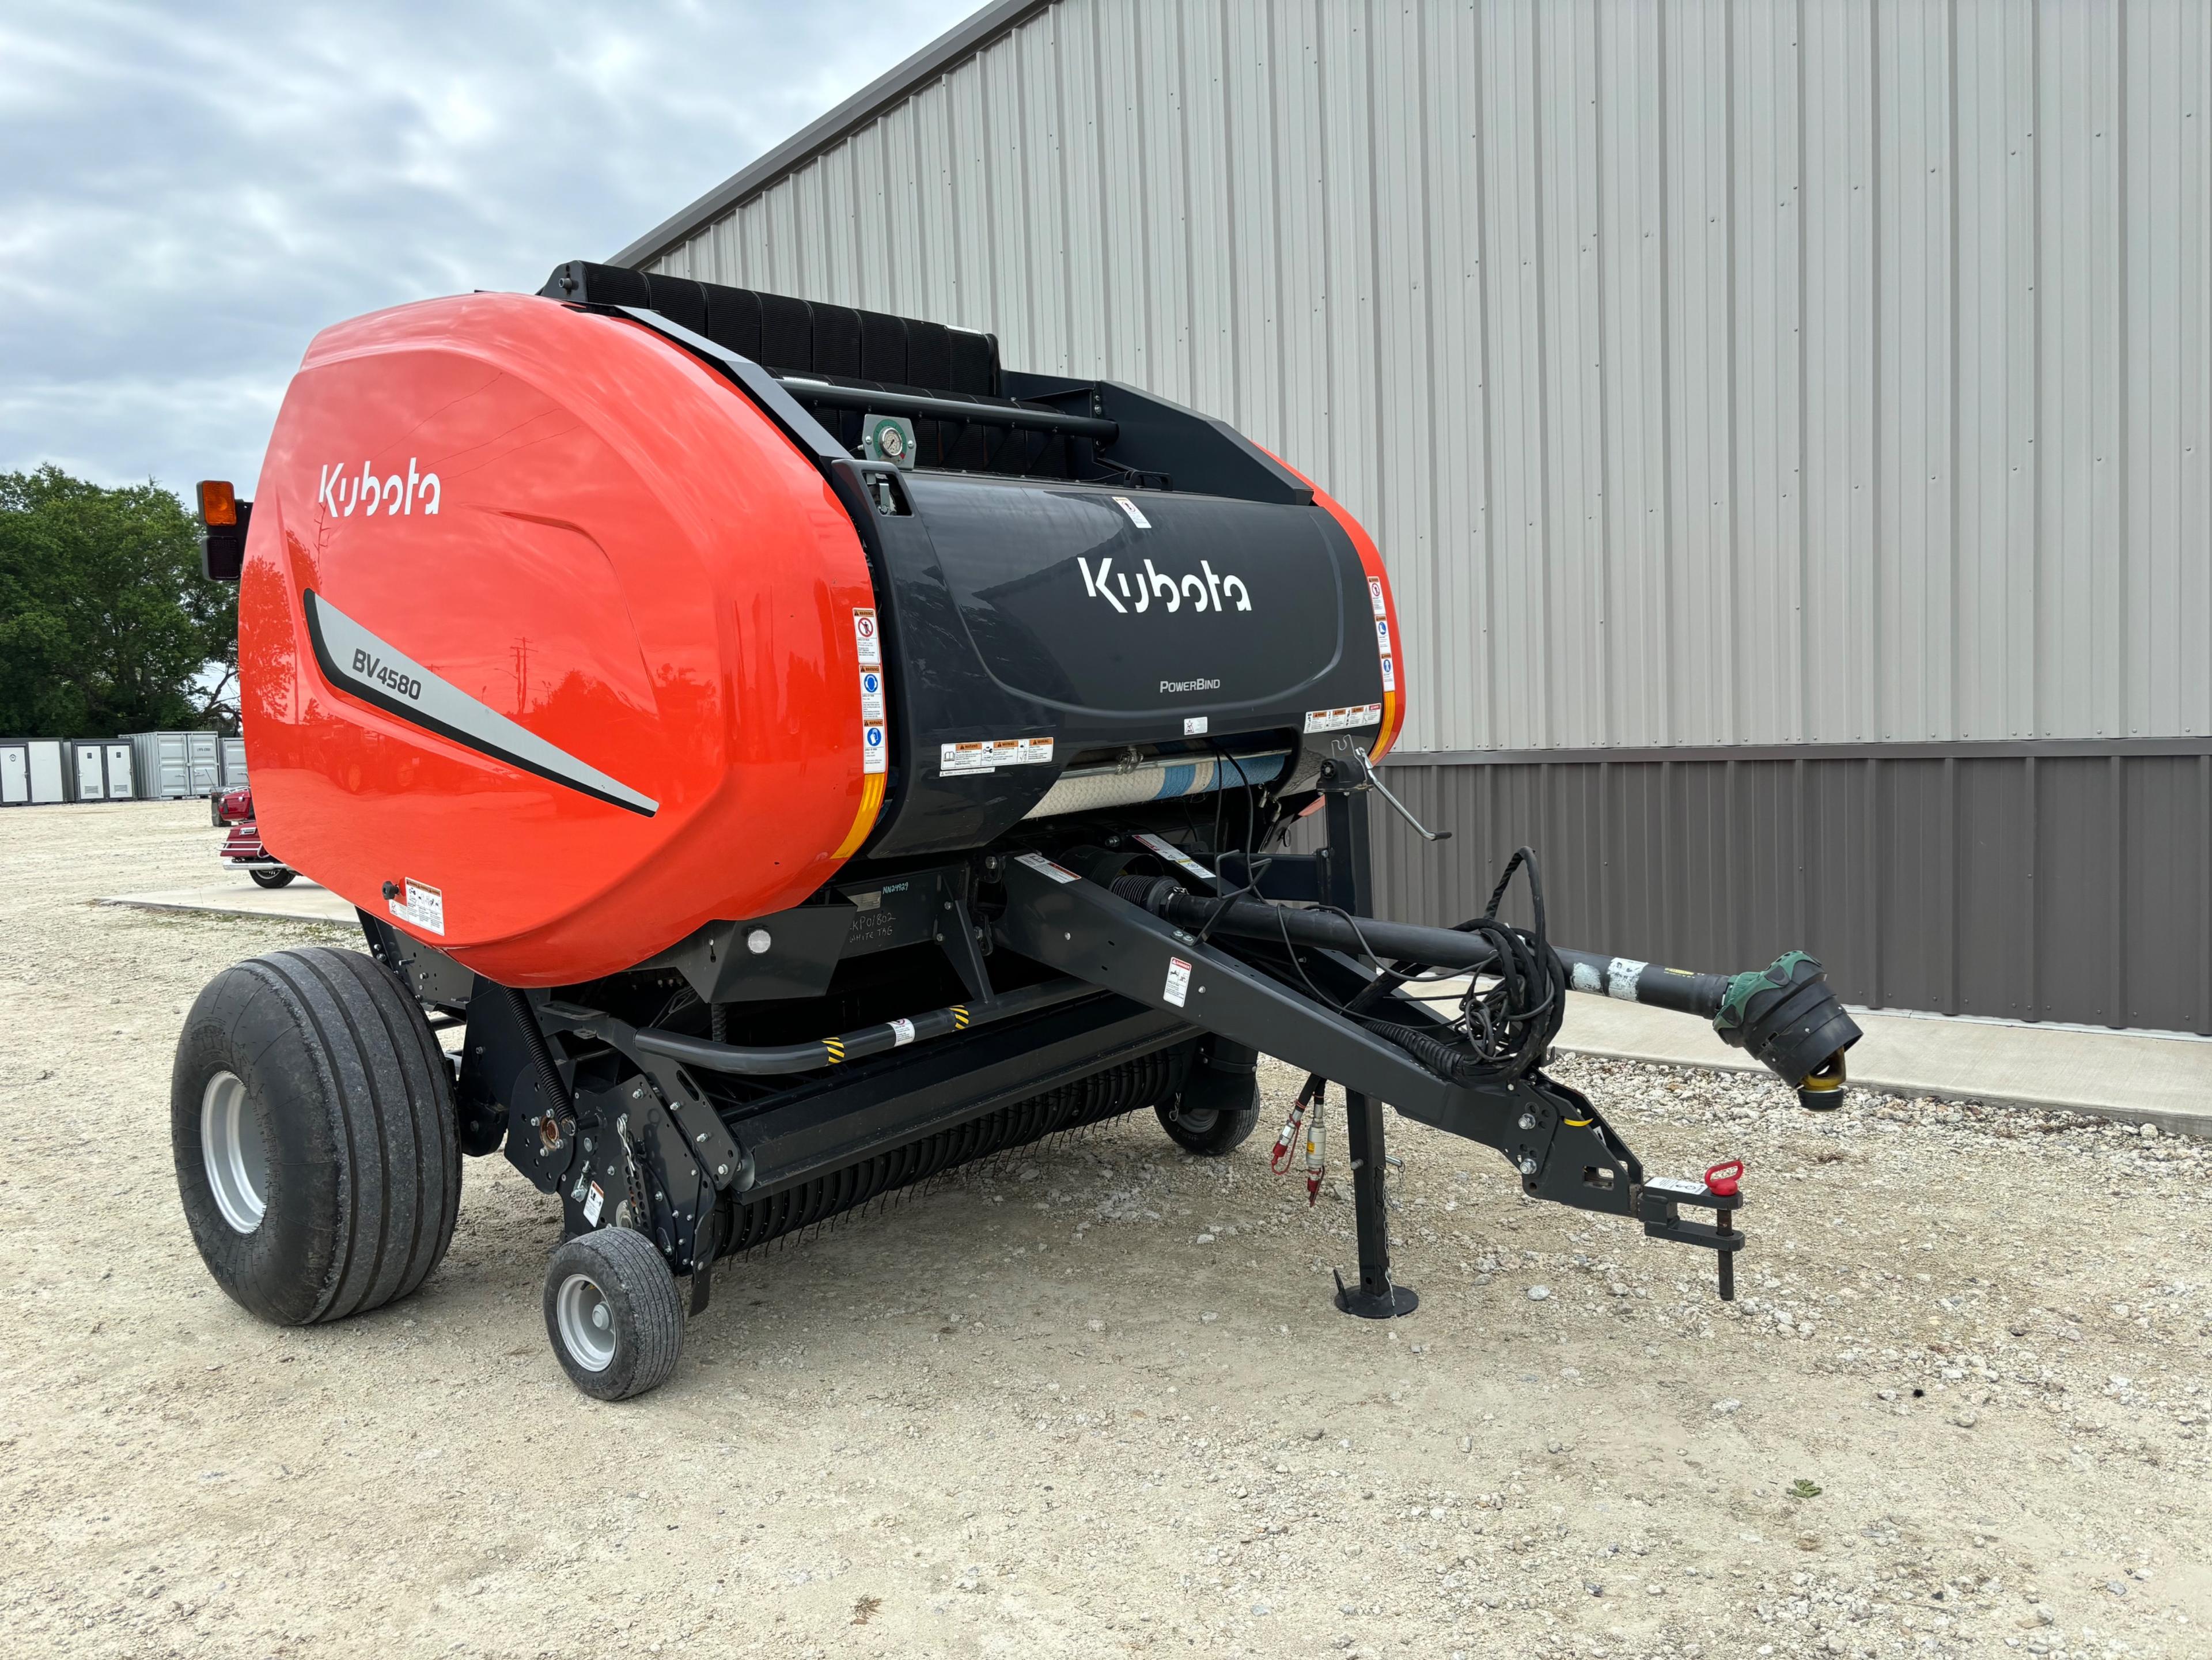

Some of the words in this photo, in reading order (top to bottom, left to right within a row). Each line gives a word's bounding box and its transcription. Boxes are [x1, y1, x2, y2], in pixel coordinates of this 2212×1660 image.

[319, 457, 441, 517] Kubota
[1077, 557, 1252, 613] Kubota
[353, 648, 421, 700] BV4580
[849, 932, 874, 943] WHITE
[877, 925, 893, 936] TAG
